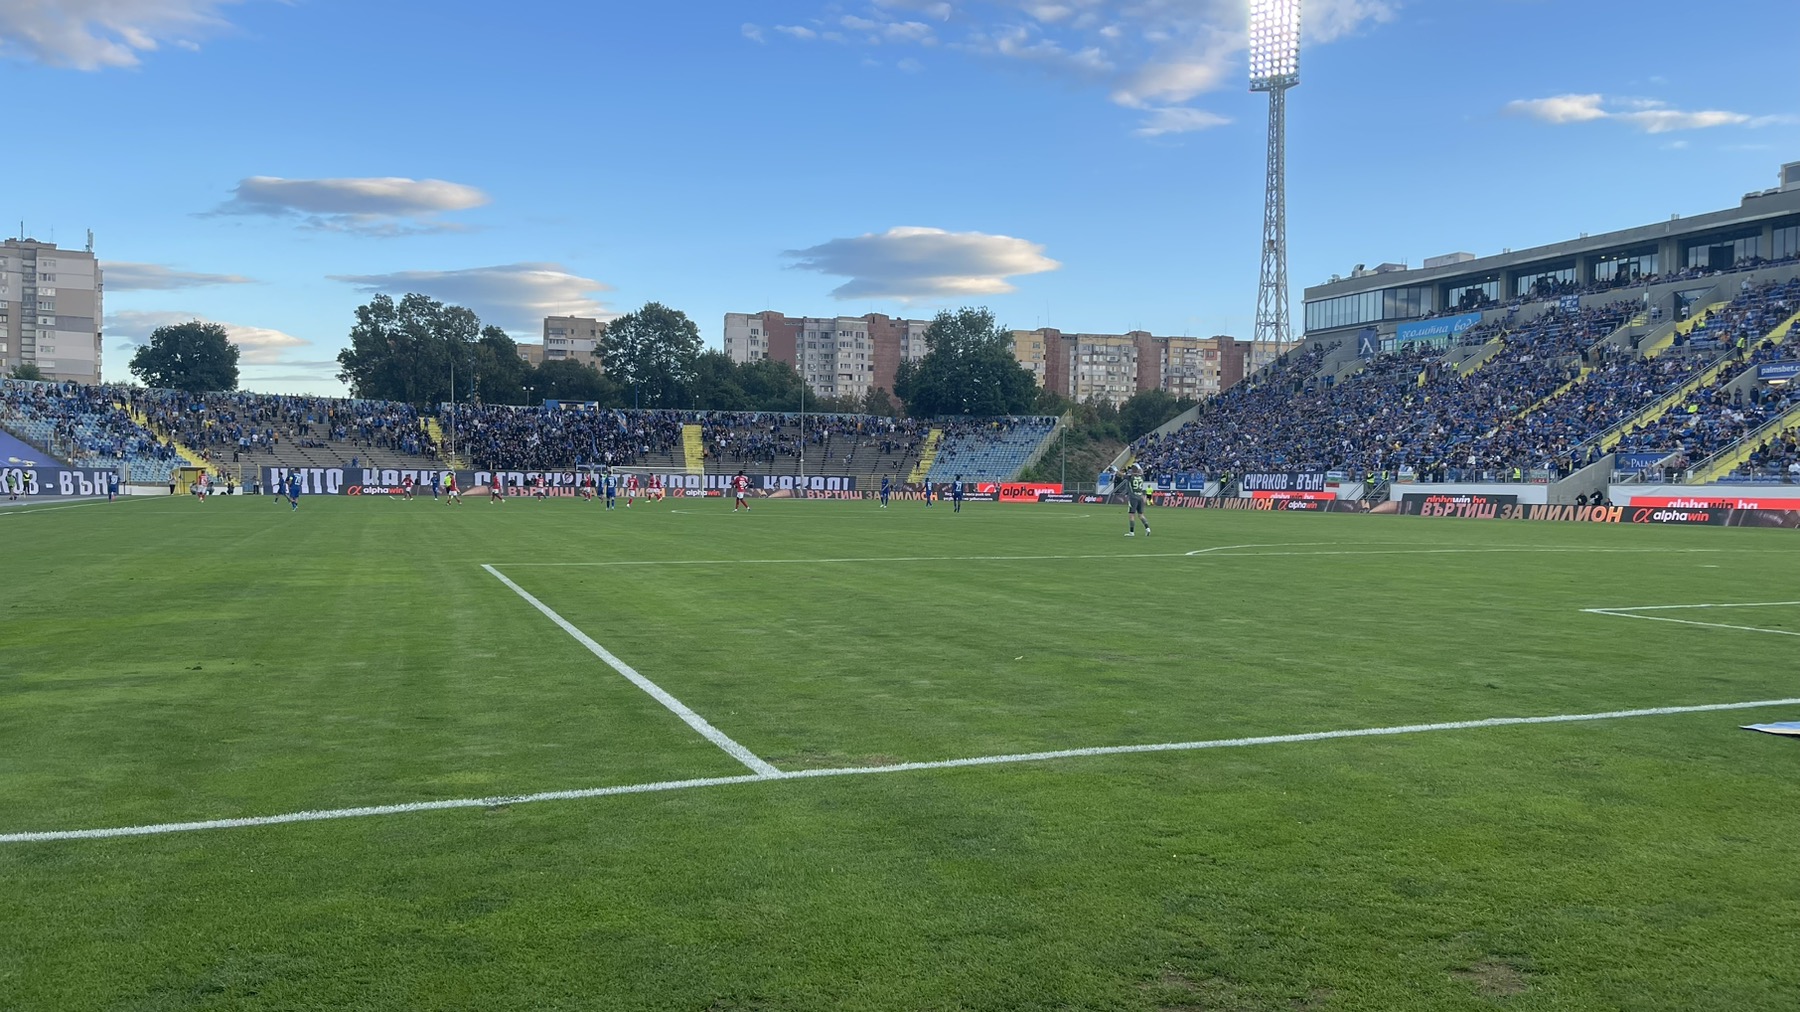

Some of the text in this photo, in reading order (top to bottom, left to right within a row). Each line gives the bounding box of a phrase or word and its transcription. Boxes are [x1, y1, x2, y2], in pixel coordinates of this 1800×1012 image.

[60, 471, 113, 495] ВЪН
[1296, 473, 1324, 490] ВЪН!
[363, 486, 405, 495] alphawin
[1002, 486, 1055, 498] alphawin
[1163, 496, 1274, 510] ВЪРТИШ ЗА МИЛИОН
[1288, 501, 1317, 509] alphawin
[1421, 502, 1624, 522] ВЪРТИШ ЗА МИЛИОН
[1653, 510, 1709, 522] alphawin
